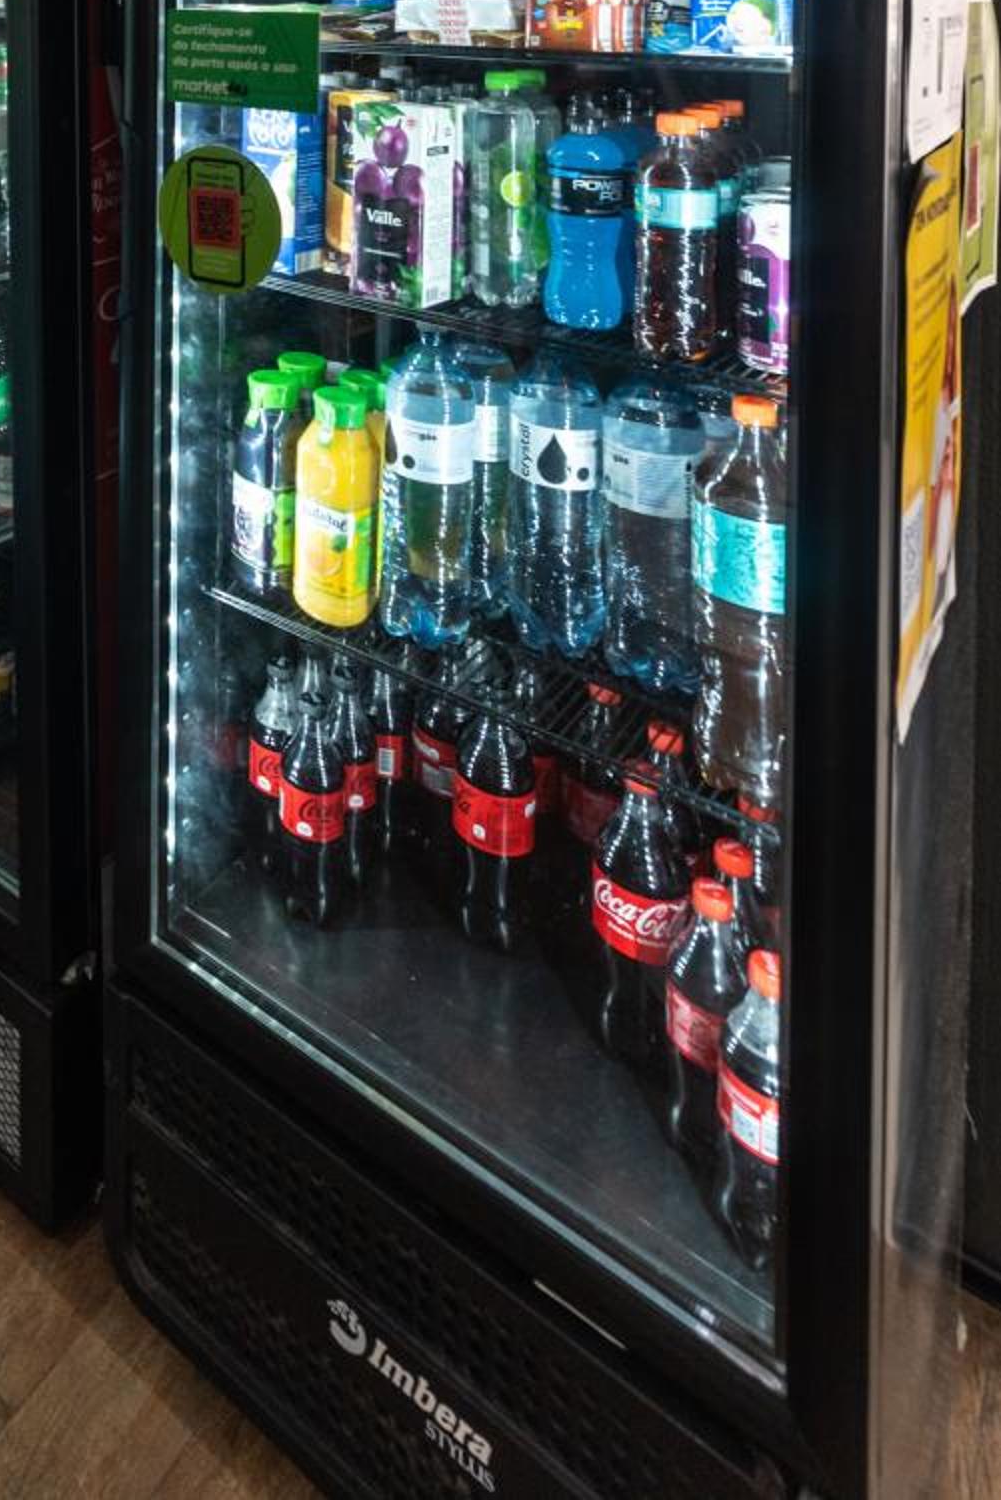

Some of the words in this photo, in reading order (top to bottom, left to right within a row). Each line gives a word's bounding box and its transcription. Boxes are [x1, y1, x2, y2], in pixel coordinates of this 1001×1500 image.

[366, 207, 403, 227] Valle
[367, 1338, 493, 1467] Imbera
[424, 1418, 496, 1493] STYLUS
